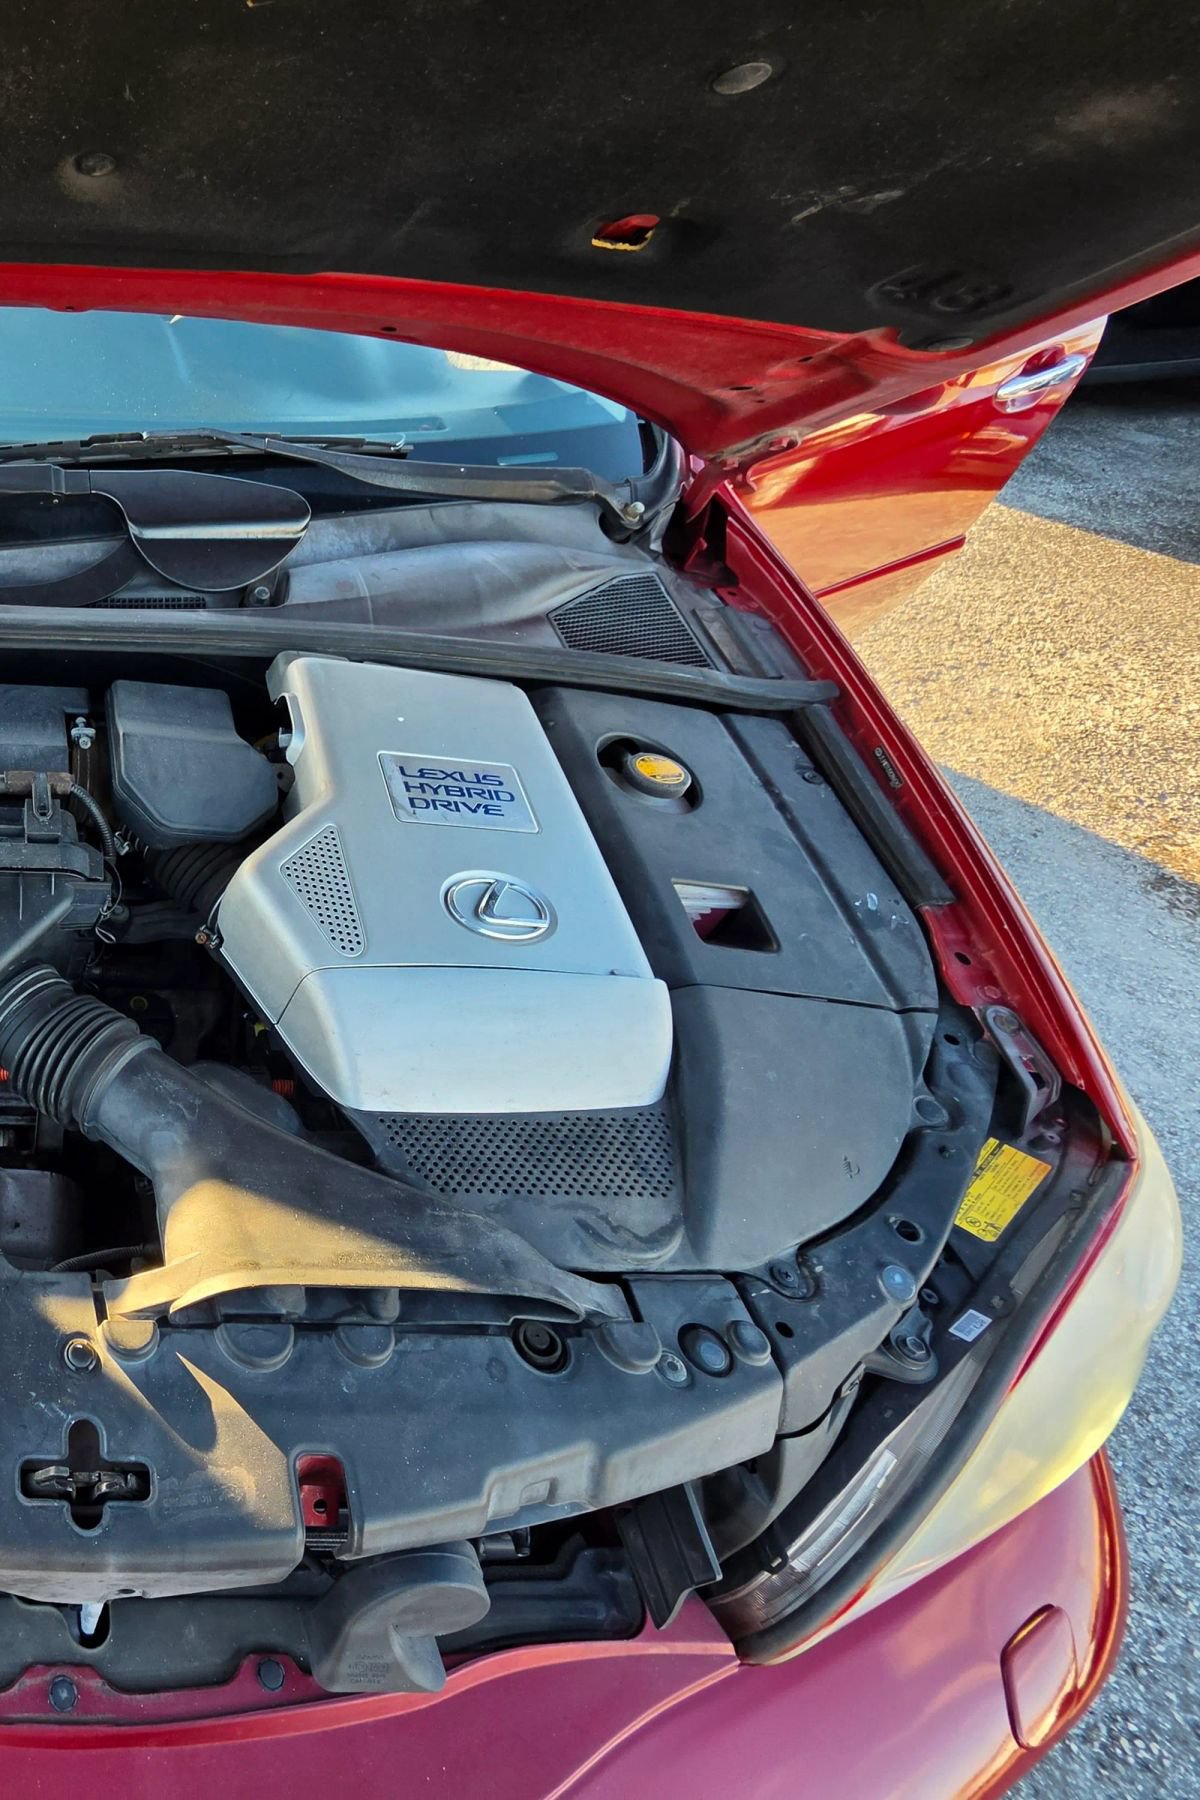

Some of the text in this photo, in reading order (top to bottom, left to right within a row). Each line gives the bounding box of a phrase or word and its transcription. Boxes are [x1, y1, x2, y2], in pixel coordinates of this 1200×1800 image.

[398, 765, 504, 787] LEXUS
[403, 781, 515, 803] HYBRID
[408, 796, 505, 817] DRIVE
